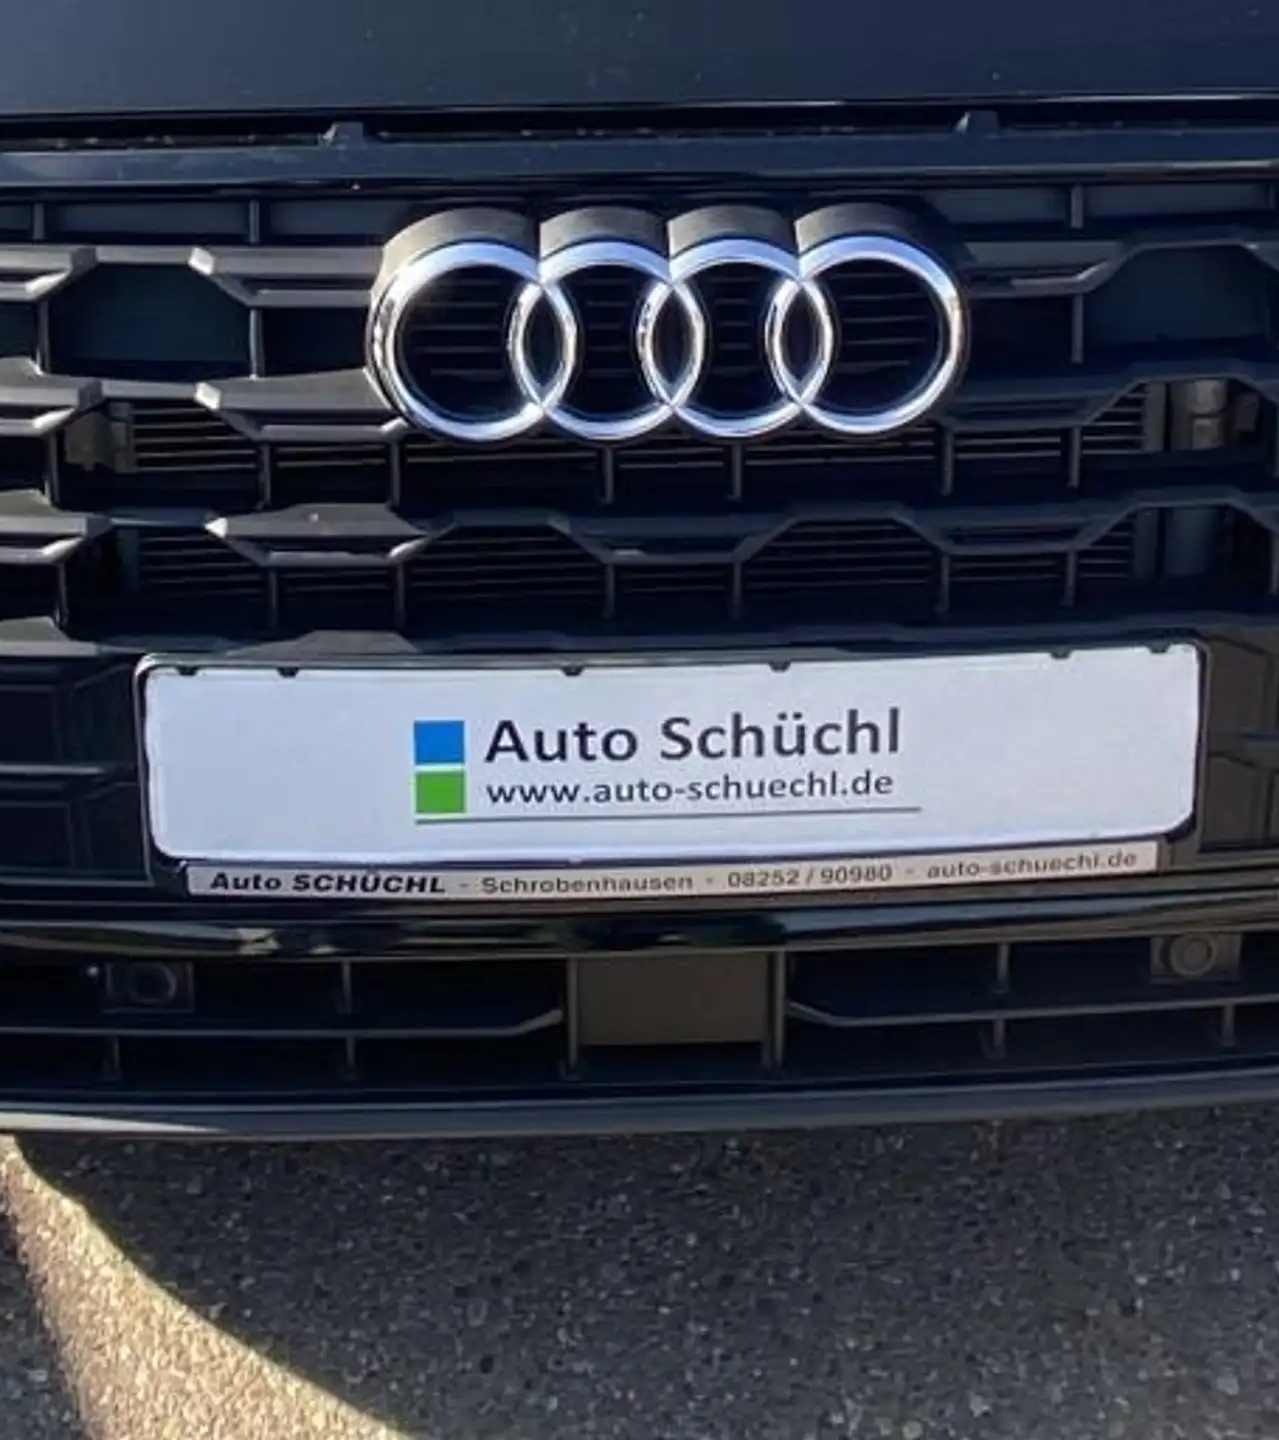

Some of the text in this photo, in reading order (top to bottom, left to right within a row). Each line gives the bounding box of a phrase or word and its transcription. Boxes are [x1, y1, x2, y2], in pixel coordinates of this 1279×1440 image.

[485, 706, 901, 764] Auto Schüchl
[486, 768, 895, 805] www.auto-schuechl.de
[209, 871, 283, 892] Auto
[291, 868, 447, 894] SCHÜCHL
[480, 874, 694, 895] Schrobenhausen
[926, 850, 1139, 880] auto-schuechl.de
